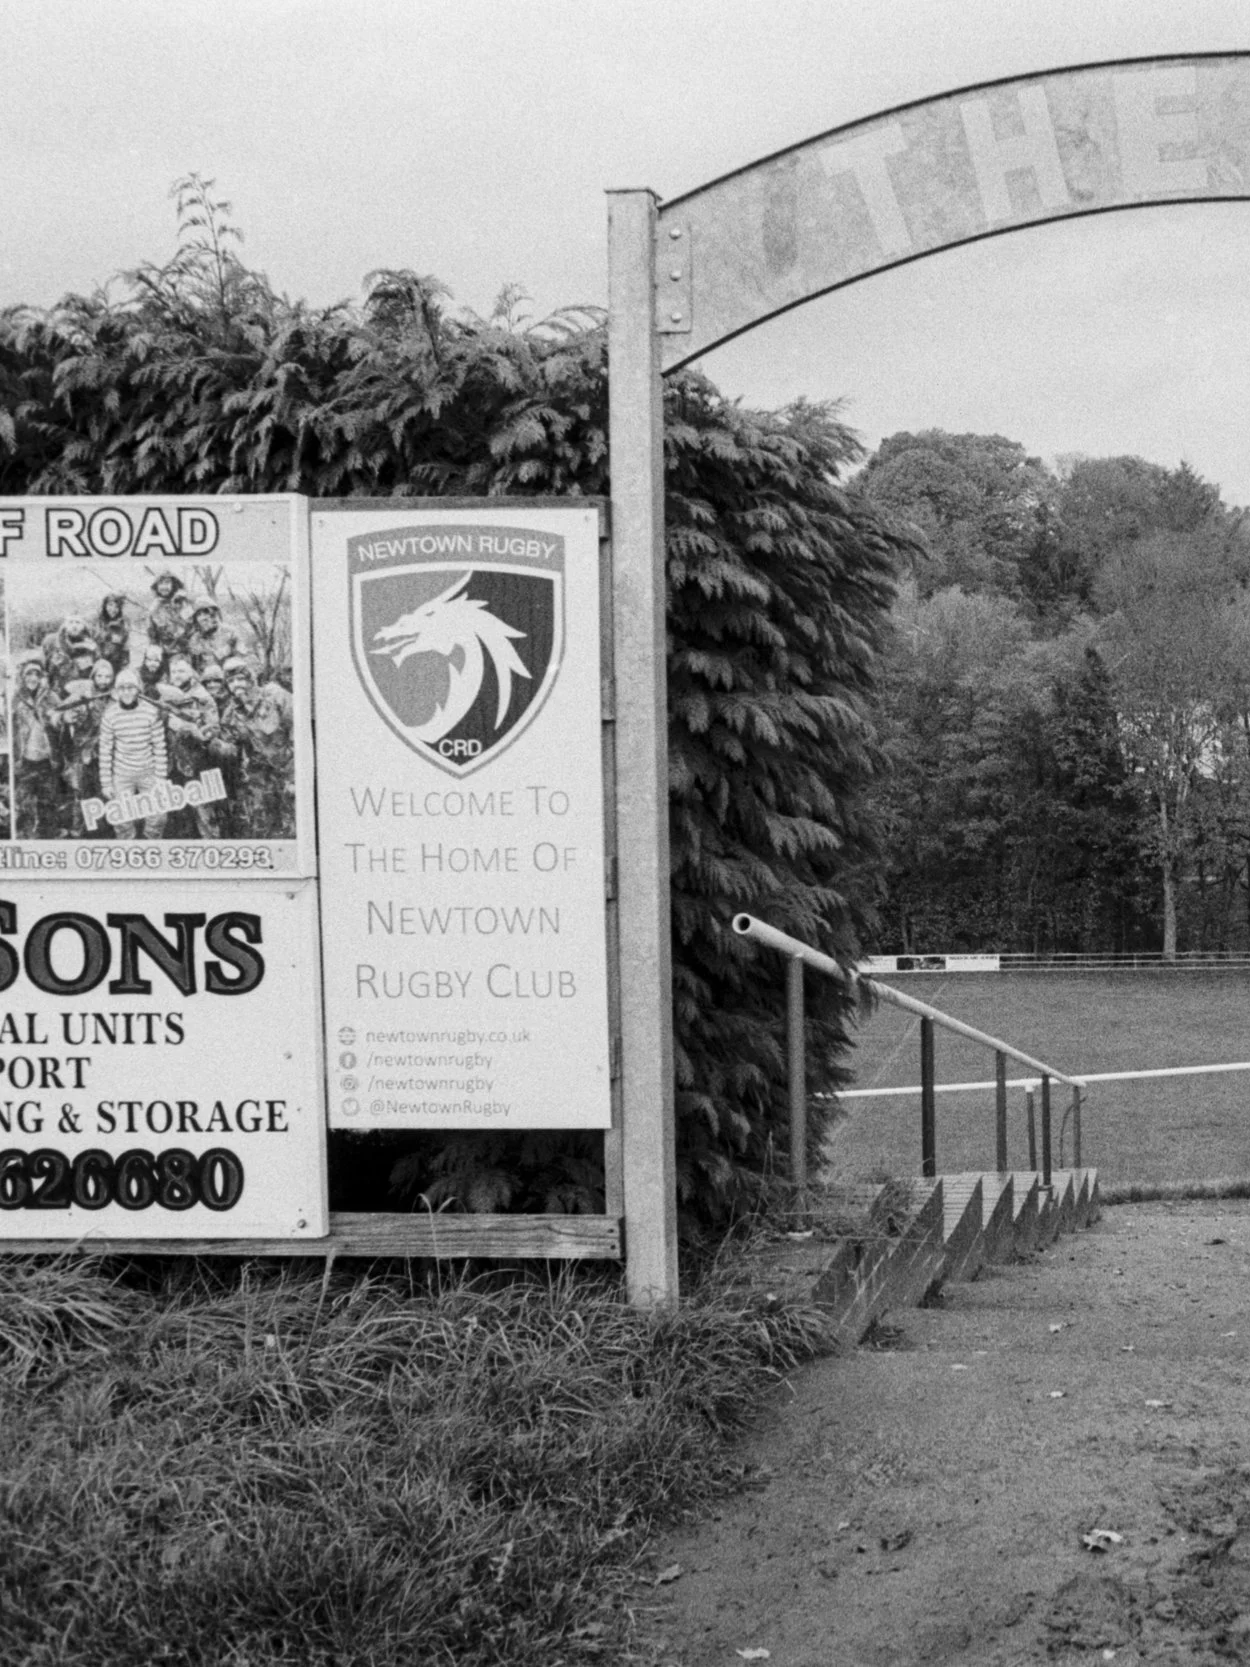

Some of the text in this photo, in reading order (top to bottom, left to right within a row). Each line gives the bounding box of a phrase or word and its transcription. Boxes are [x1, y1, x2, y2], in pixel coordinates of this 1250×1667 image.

[816, 65, 1210, 257] THE
[45, 506, 220, 558] ROAD
[358, 535, 557, 561] NEWTOWN RUGBY
[438, 739, 482, 757] CRD
[81, 768, 227, 831] Paintball
[0, 845, 272, 869] line: 07966 370293
[60, 1012, 185, 1046] UNITS
[365, 1028, 531, 1046] newtownrugby.co.uk
[367, 1052, 493, 1070] /newtownrugby
[367, 1075, 494, 1093] /newtownrugby
[58, 1103, 83, 1134] &
[97, 1099, 289, 1134] STORAGE
[370, 1100, 511, 1117] @NewtownRugby
